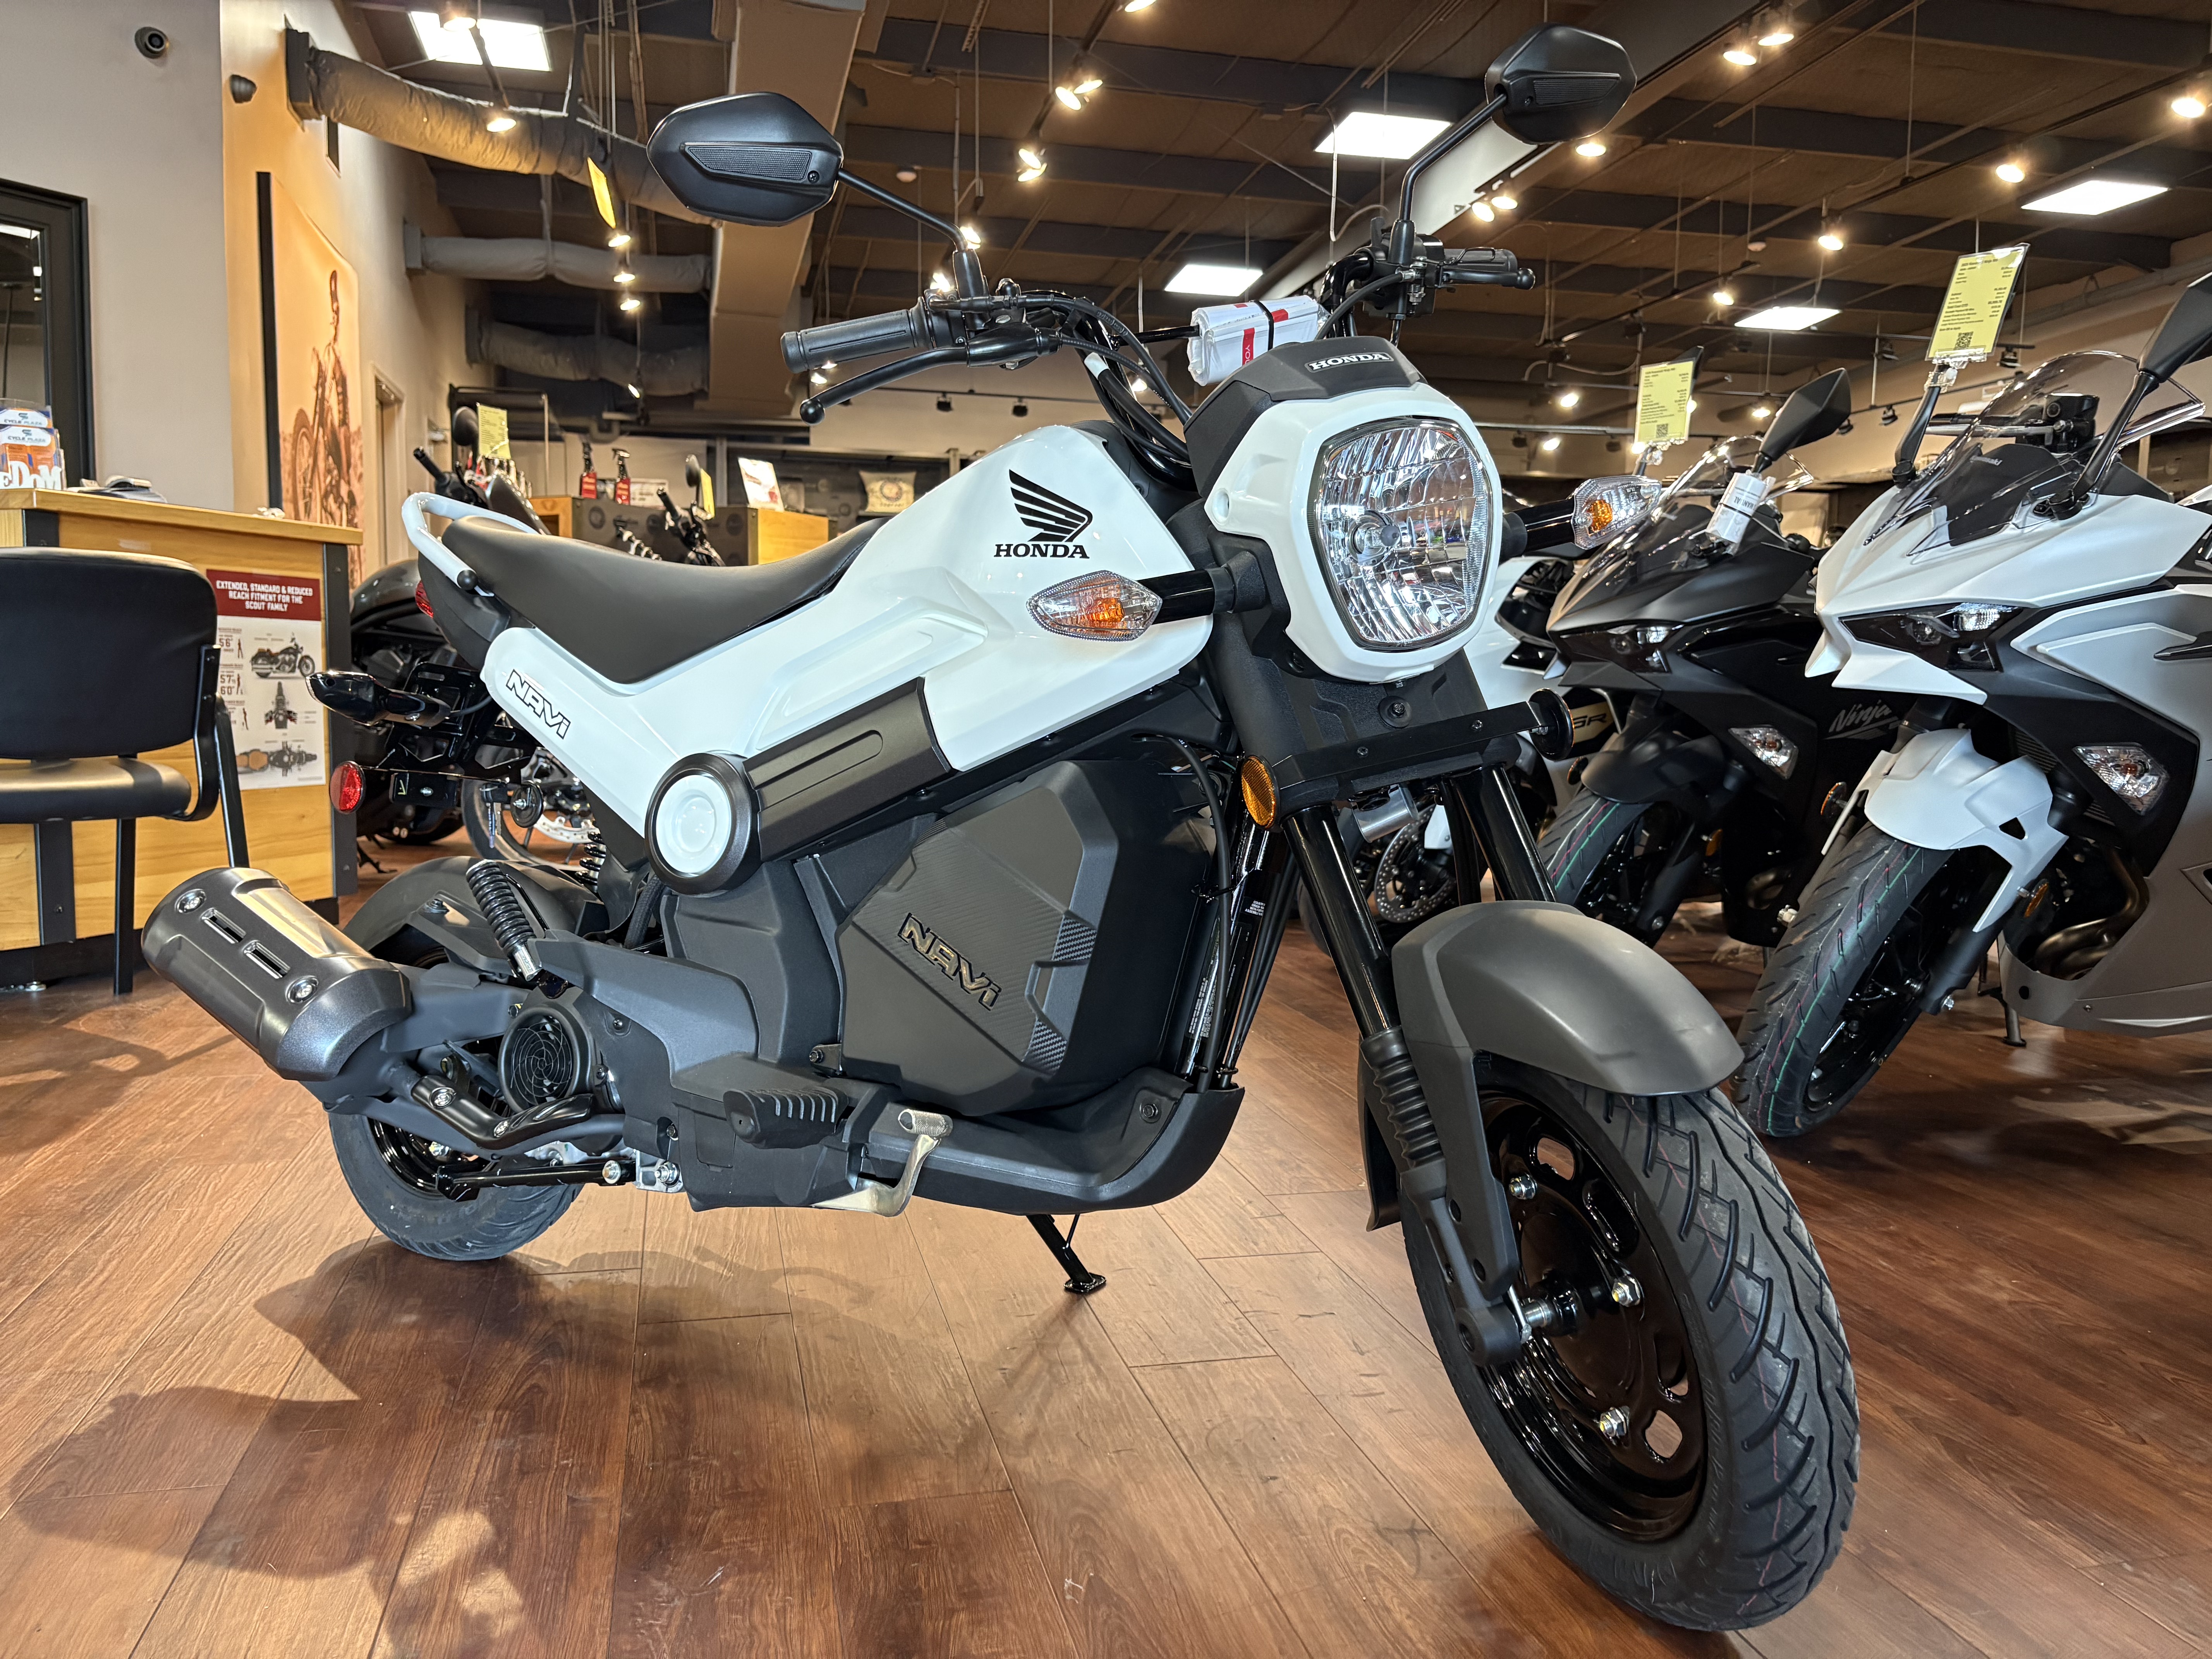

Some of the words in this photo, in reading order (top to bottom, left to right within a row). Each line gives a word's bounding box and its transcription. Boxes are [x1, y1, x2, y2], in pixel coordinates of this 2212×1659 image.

[1309, 353, 1390, 370] HONDA
[994, 543, 1090, 559] HONDA
[216, 580, 249, 591] EXTENDED,
[250, 583, 280, 594] STANDARD
[287, 586, 313, 596] REDUCED
[228, 591, 249, 600] REACH
[251, 592, 276, 602] FITMENT
[278, 594, 290, 603] FOR
[291, 596, 303, 605] THE
[246, 601, 266, 610] SCOUT
[267, 603, 288, 612] FAMILY
[1829, 699, 1892, 733] Ninja
